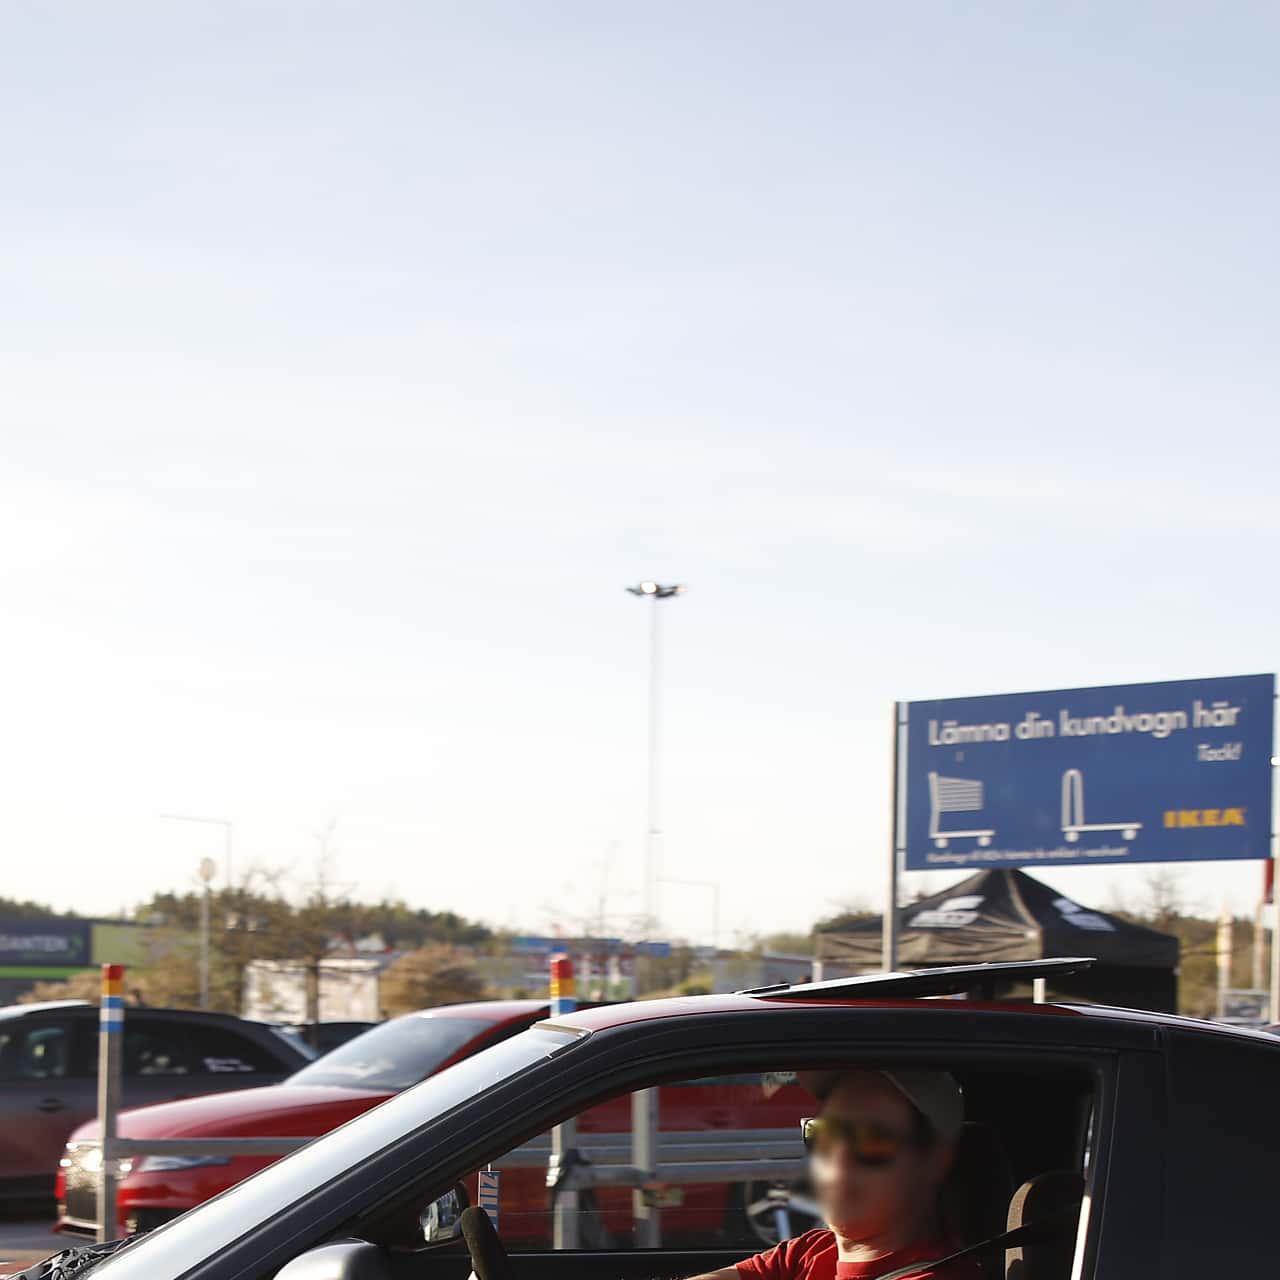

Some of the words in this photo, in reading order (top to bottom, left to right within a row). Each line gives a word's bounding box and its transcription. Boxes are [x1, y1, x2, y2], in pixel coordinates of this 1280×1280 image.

[928, 719, 1010, 746] Lämna
[1015, 711, 1055, 740] din
[1058, 705, 1188, 738] kundvagn
[1192, 700, 1241, 728] här
[1164, 808, 1246, 828] IKEA
